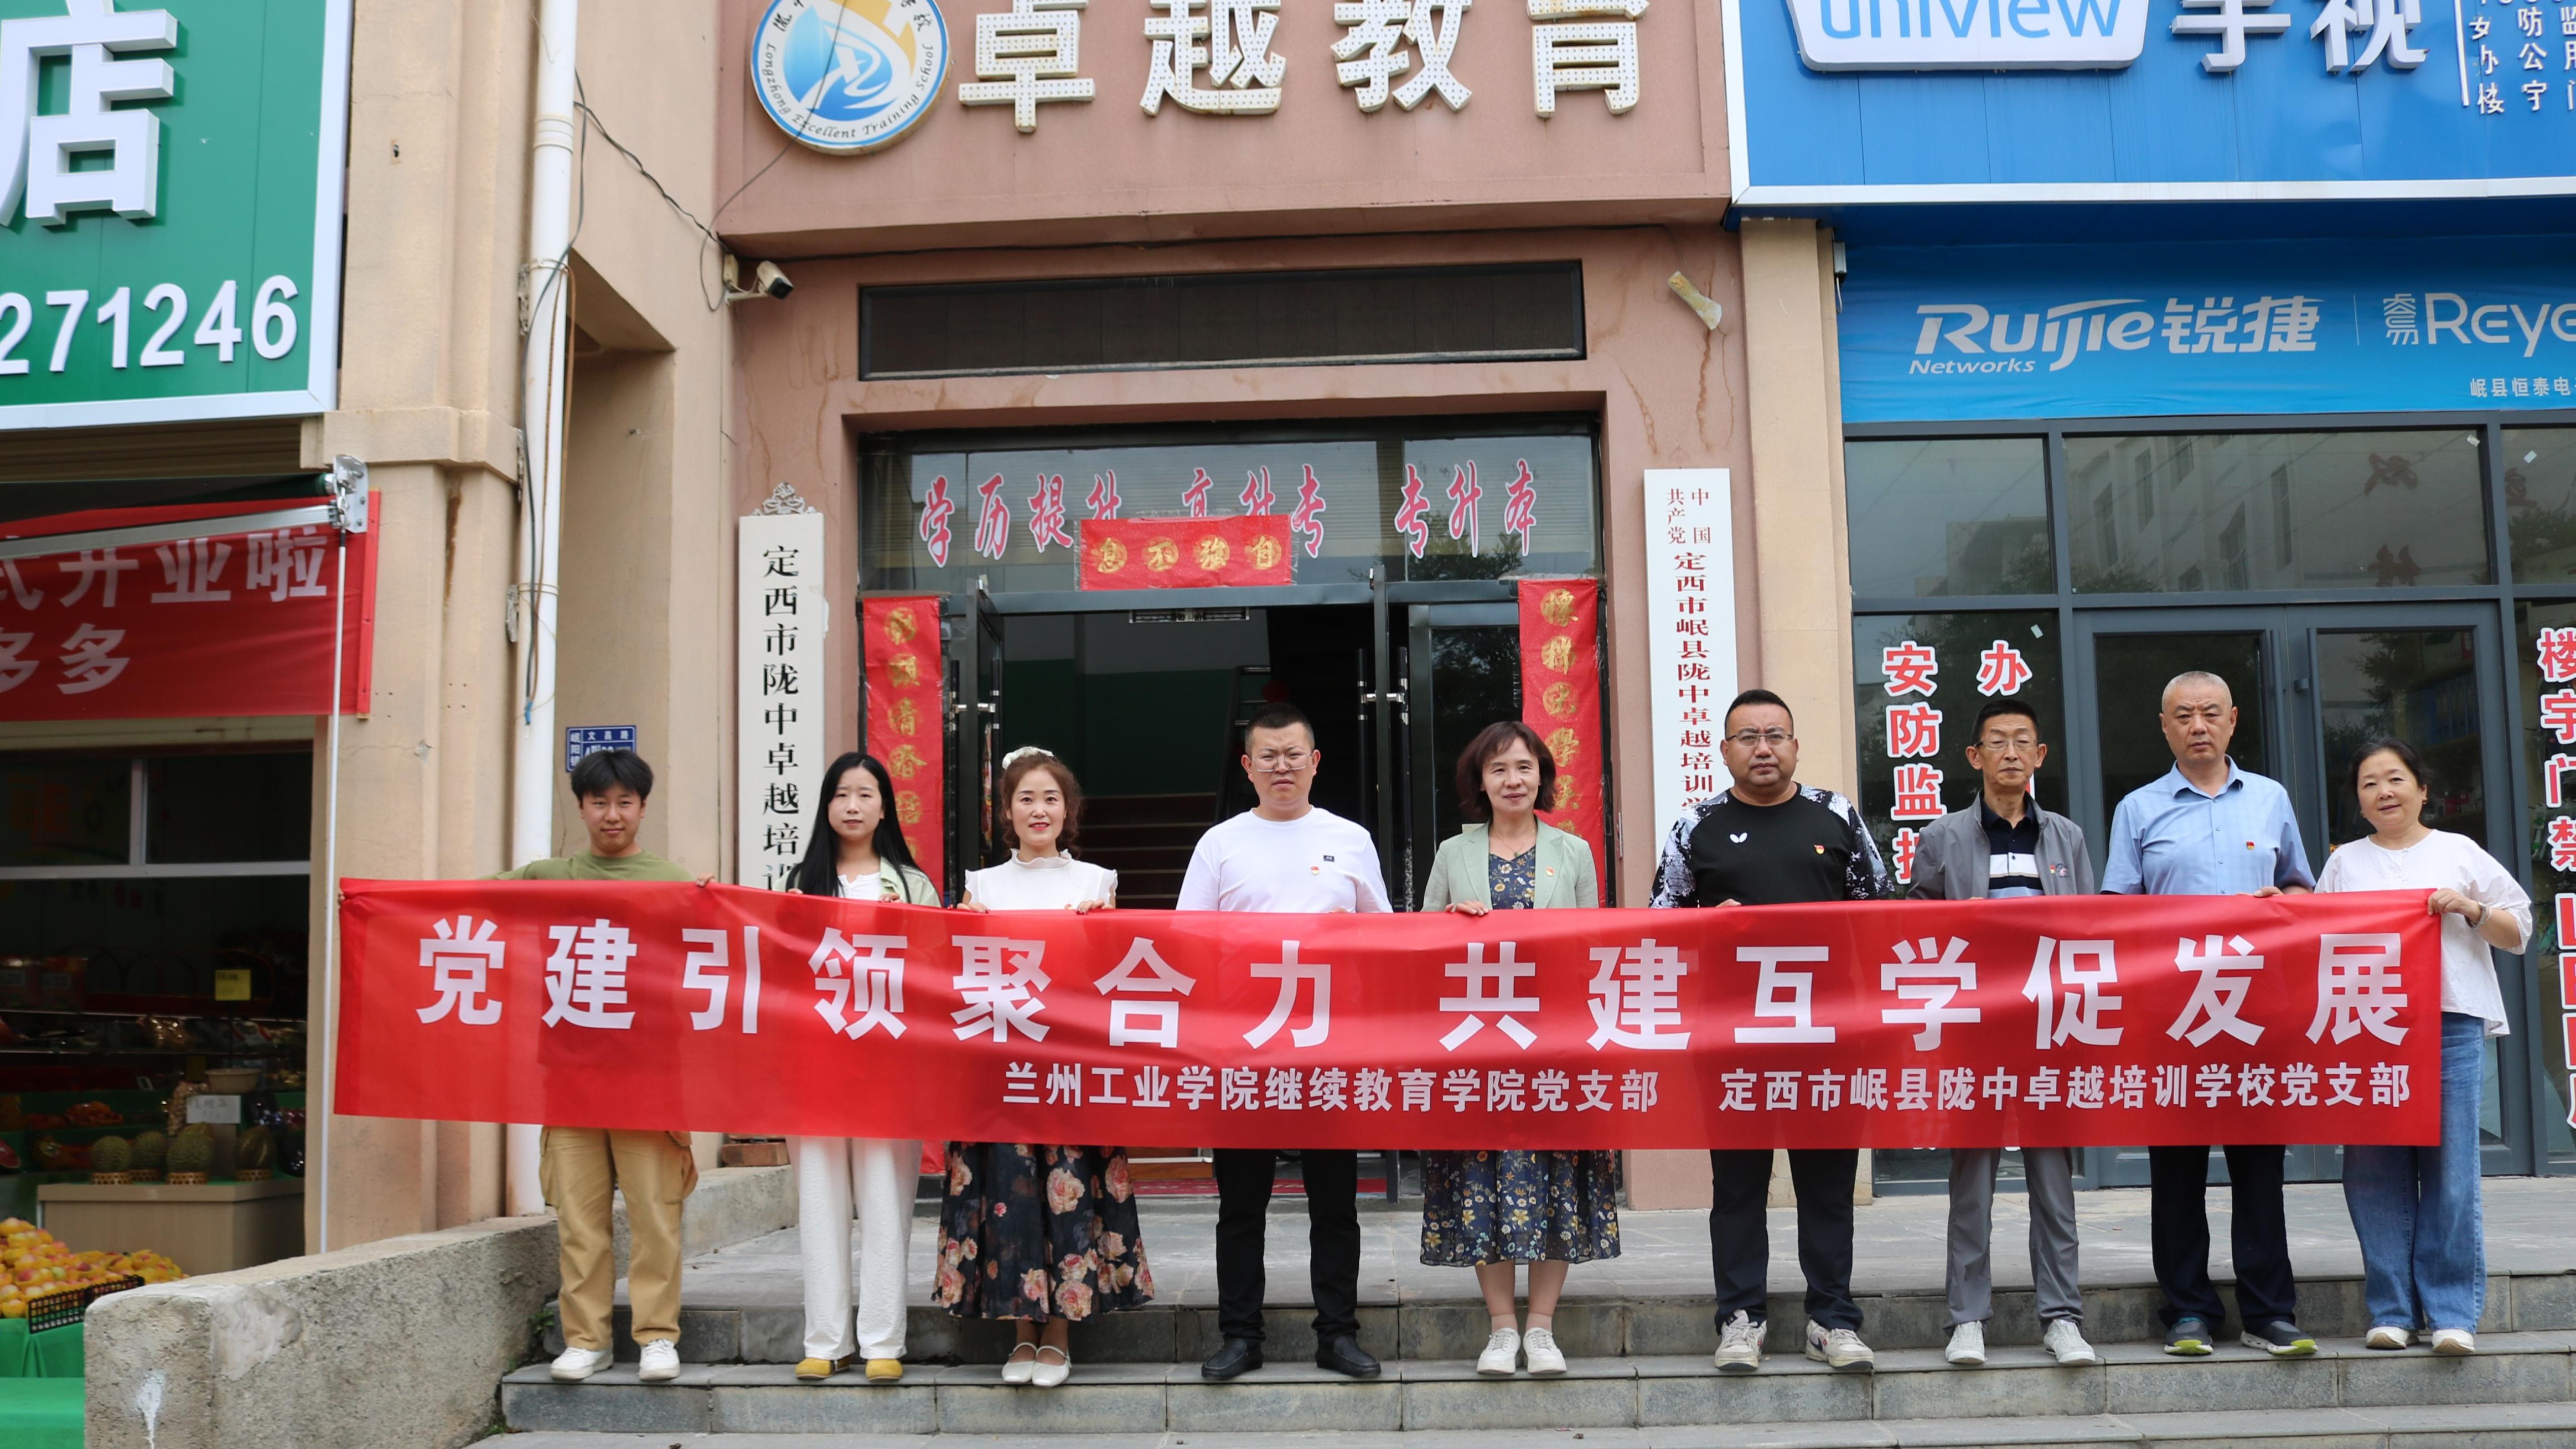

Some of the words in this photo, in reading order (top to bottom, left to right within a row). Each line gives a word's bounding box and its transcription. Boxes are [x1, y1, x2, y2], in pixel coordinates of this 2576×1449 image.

[0, 0, 178, 226] 店
[762, 43, 792, 115] Longzhong
[792, 113, 857, 138] Excellent
[862, 94, 920, 136] Training
[916, 44, 934, 91] School
[959, 0, 1649, 133] 卓越教育
[0, 275, 299, 375] 271246
[1908, 359, 2036, 375] Networks
[2161, 295, 2325, 354] 锐捷
[2470, 376, 2576, 398] 岷县恒泰电
[416, 915, 1331, 1049] 党建引领聚合力
[1439, 933, 2409, 1052] 共建互学促发展
[1003, 1062, 1659, 1112] 兰州工业学院继续教育学院党支部
[1719, 1062, 2411, 1111] 定西市岷县陇中卓越培训学校党支部
